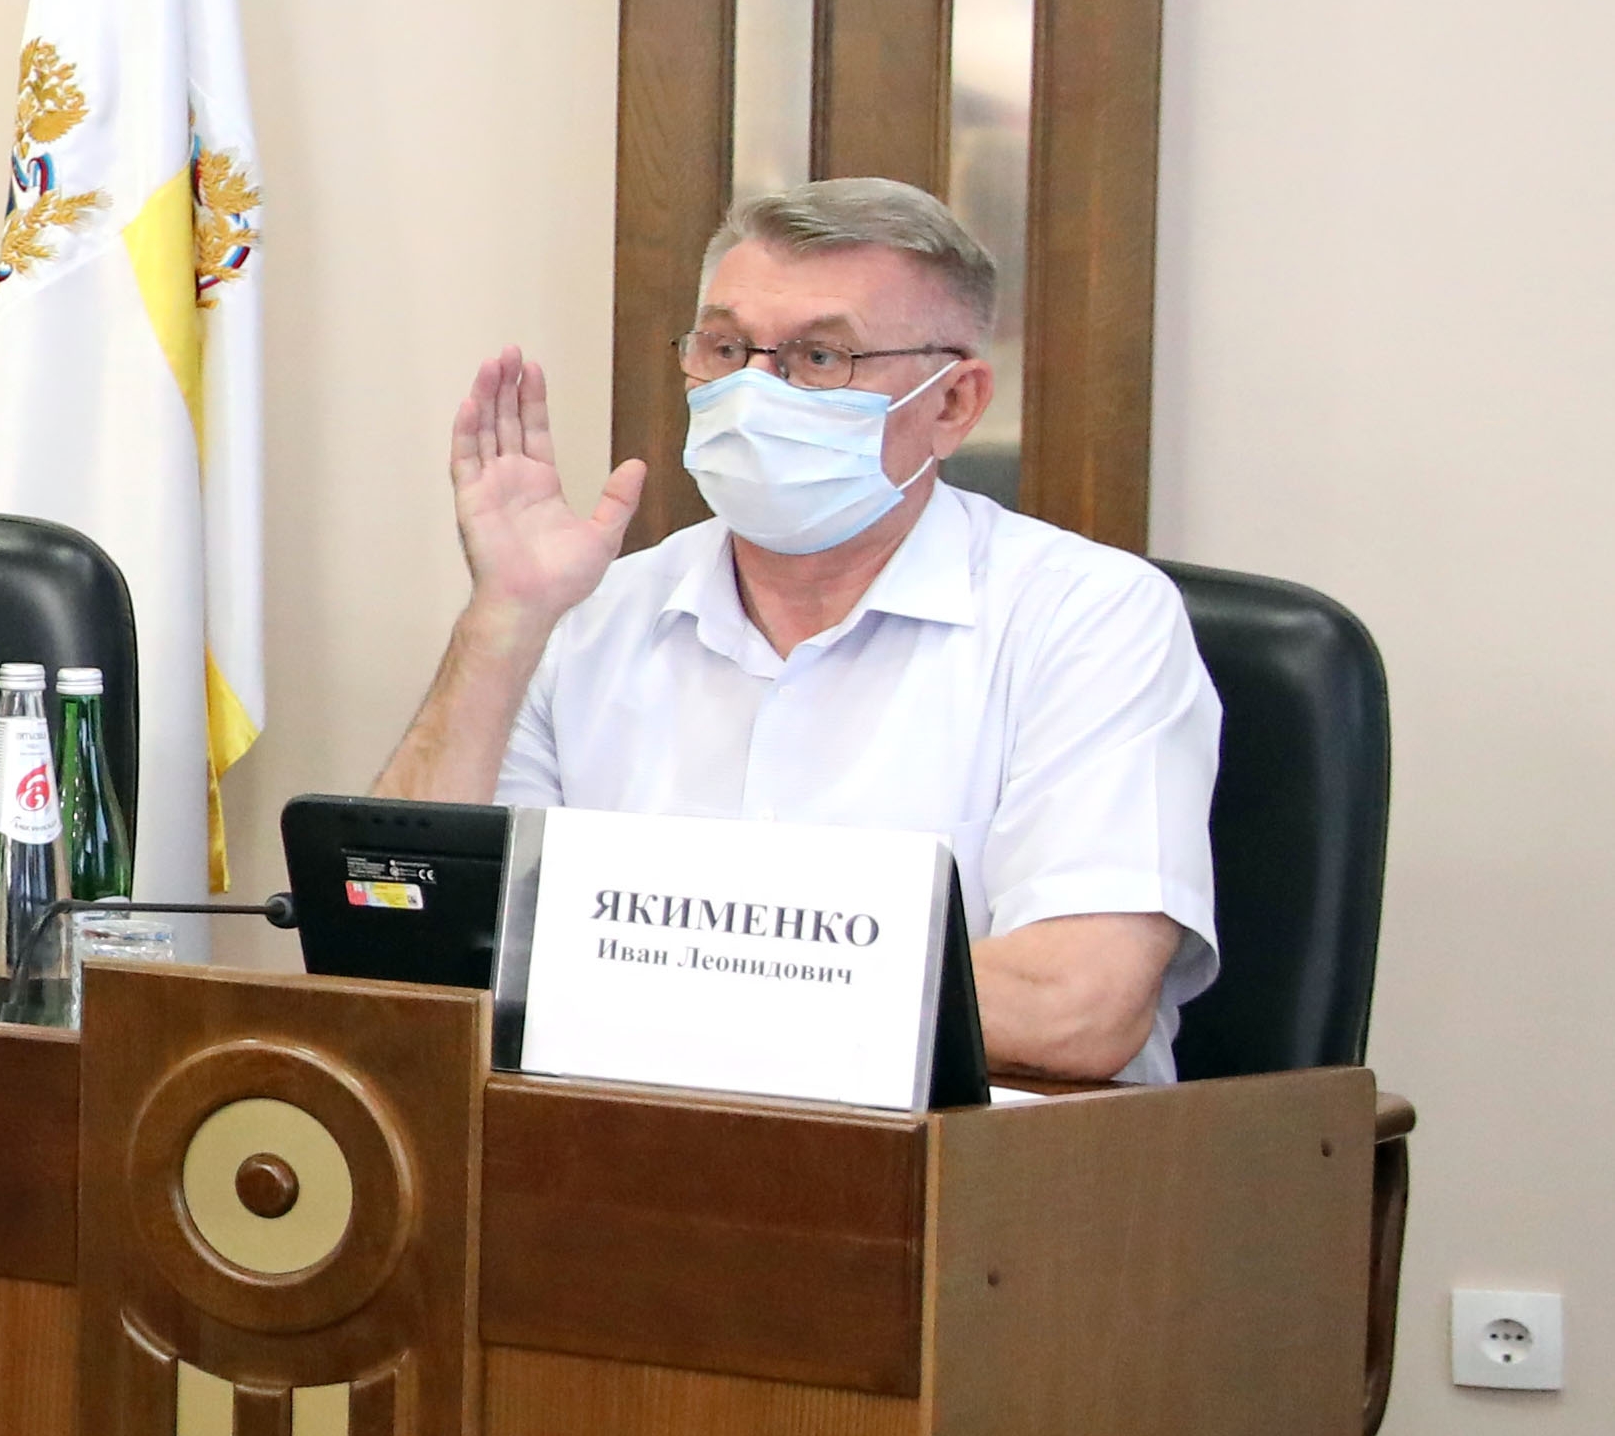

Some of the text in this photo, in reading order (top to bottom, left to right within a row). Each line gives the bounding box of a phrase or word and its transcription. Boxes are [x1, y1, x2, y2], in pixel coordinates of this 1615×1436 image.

[590, 888, 881, 948] ЯКИМЕНКО
[596, 937, 854, 986] Иван Леонидович
